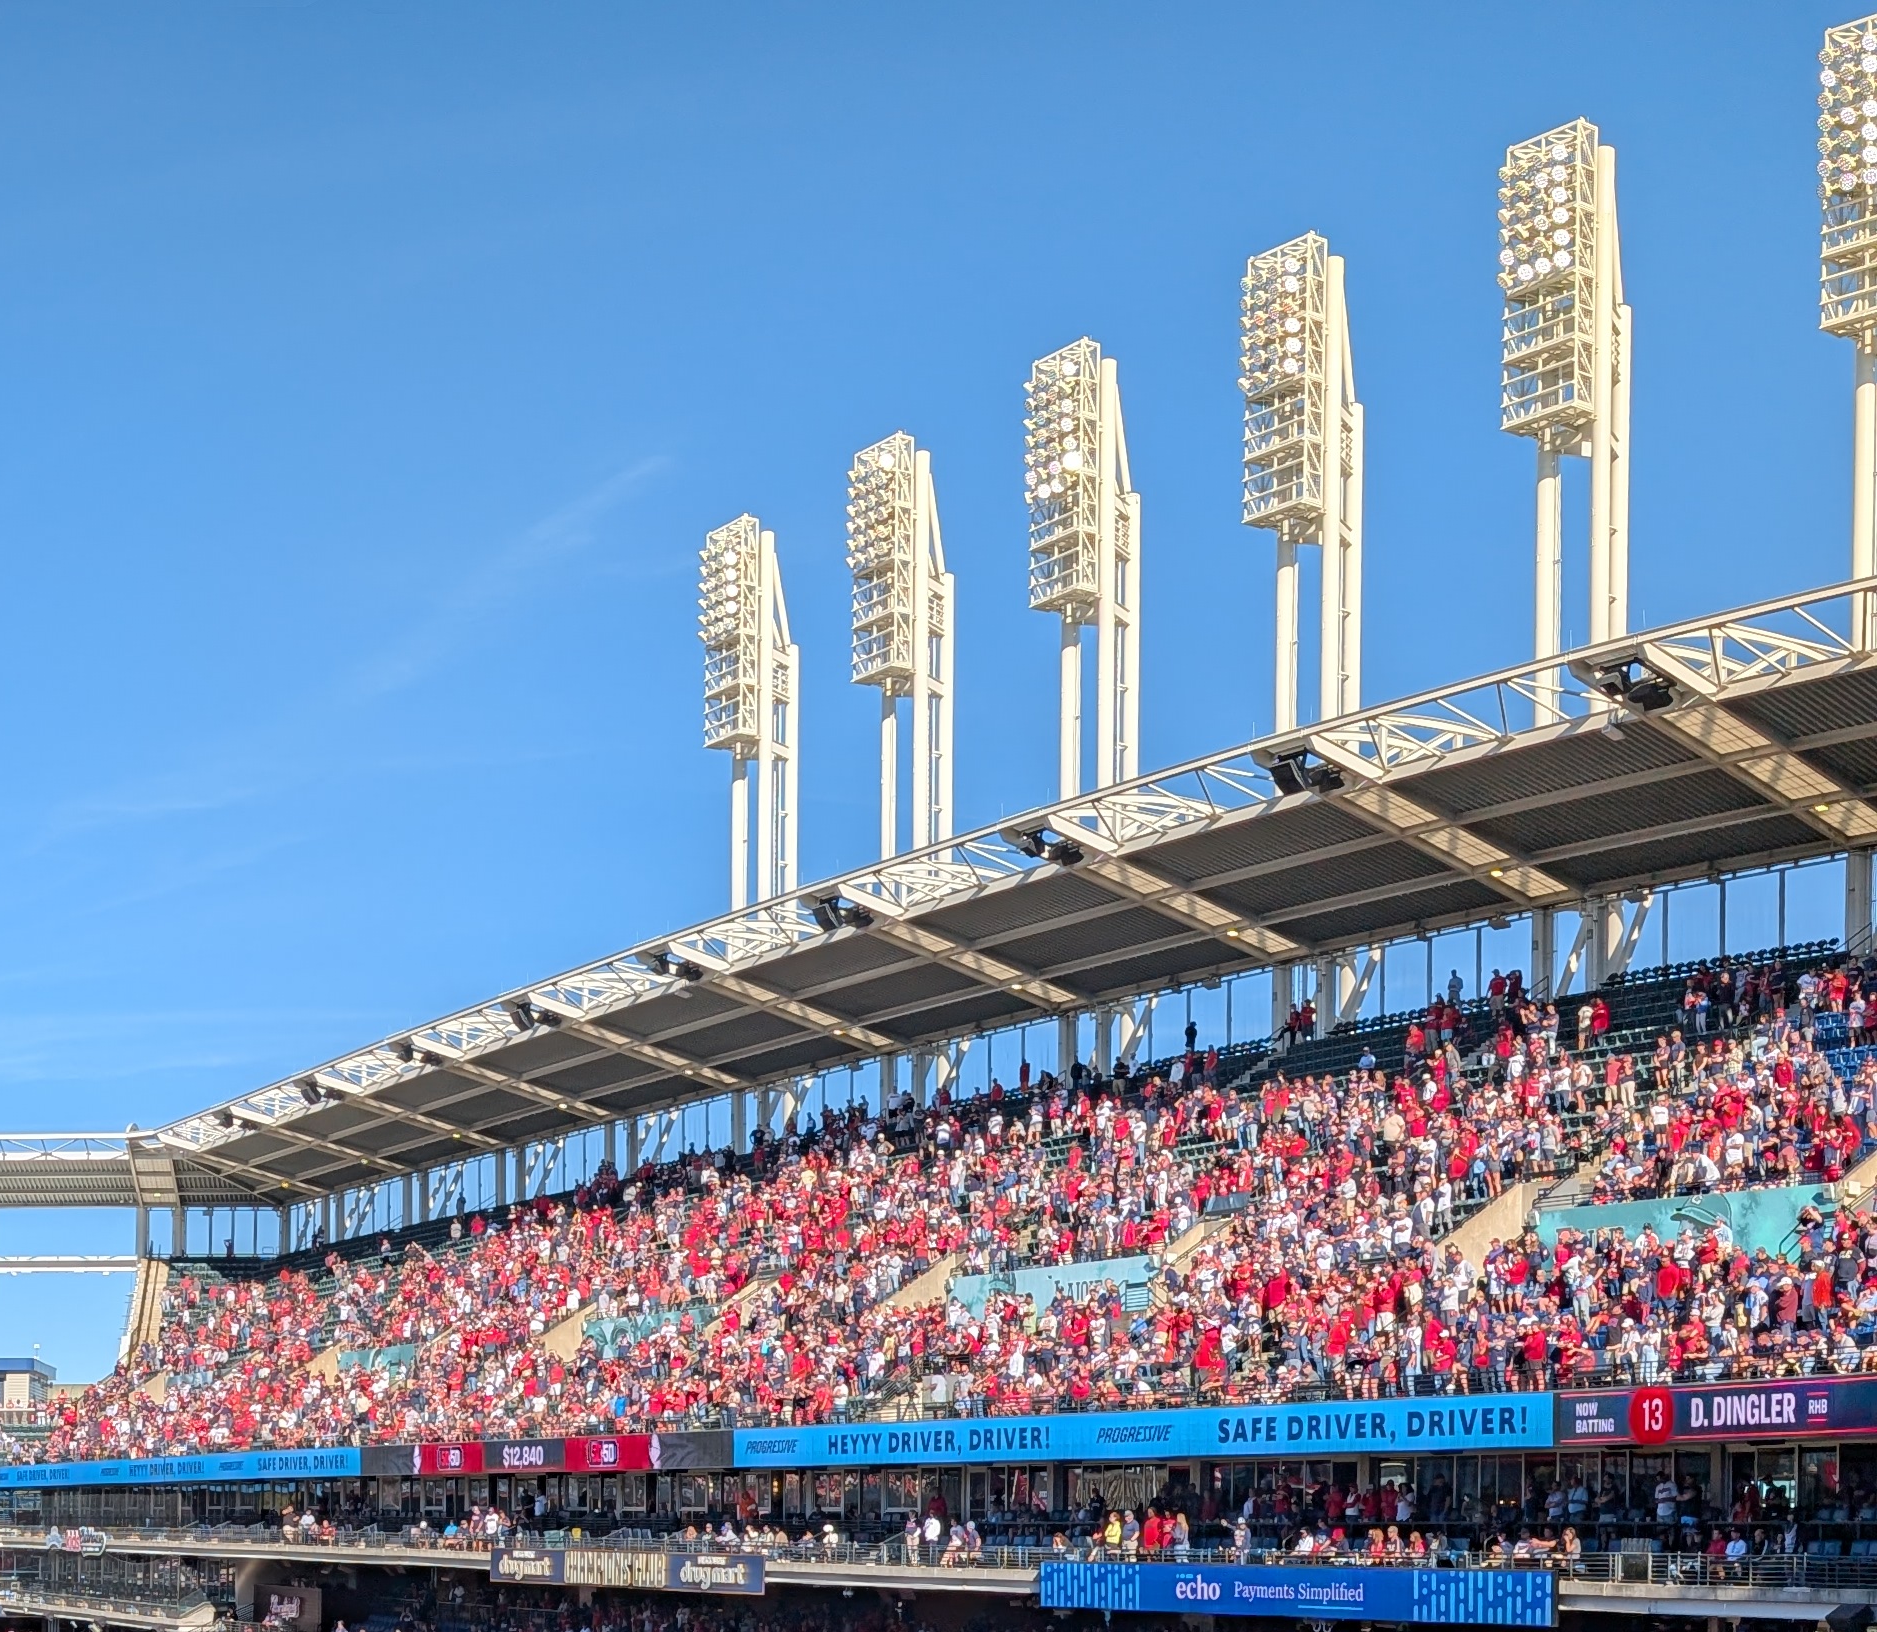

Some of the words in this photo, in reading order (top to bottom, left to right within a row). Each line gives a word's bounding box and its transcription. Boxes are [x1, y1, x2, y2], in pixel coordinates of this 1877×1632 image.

[1575, 1402, 1598, 1417] NOW
[1642, 1397, 1663, 1431] 13
[1691, 1397, 1708, 1428] D.
[1712, 1392, 1796, 1427] DINGLER
[1808, 1399, 1828, 1415] RHB
[1096, 1424, 1174, 1445] PROGRESSIVE
[1217, 1417, 1277, 1444] SAFE
[1286, 1411, 1396, 1444] DRIVER,
[1407, 1406, 1527, 1438] DRIVER!
[1575, 1418, 1614, 1434] BATTING
[745, 1437, 799, 1455] PROGRESSIVE
[827, 1432, 882, 1456] HEYYY
[888, 1428, 963, 1457] DRIVER,
[969, 1427, 1050, 1452] DRIVER!
[503, 1445, 544, 1469] $12,840
[1233, 1581, 1295, 1601] Payments
[1297, 1582, 1364, 1603] Simplified
